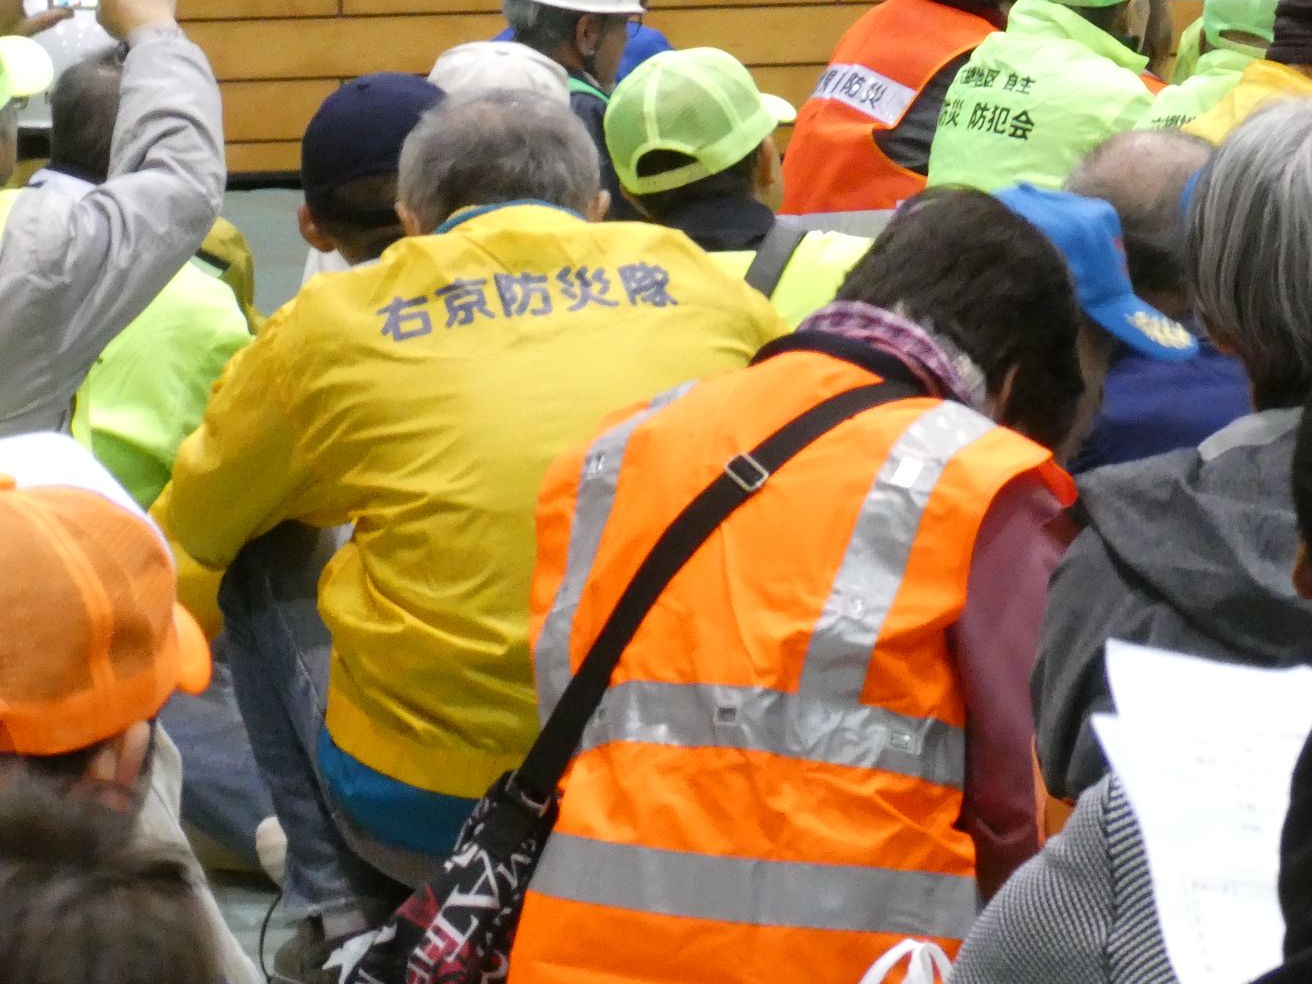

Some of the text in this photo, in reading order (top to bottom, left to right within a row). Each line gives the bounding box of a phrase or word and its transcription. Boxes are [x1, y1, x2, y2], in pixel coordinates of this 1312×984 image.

[1003, 72, 1037, 95] 自主
[966, 102, 1036, 142] 防犯会
[375, 261, 679, 343] 右京防災隊
